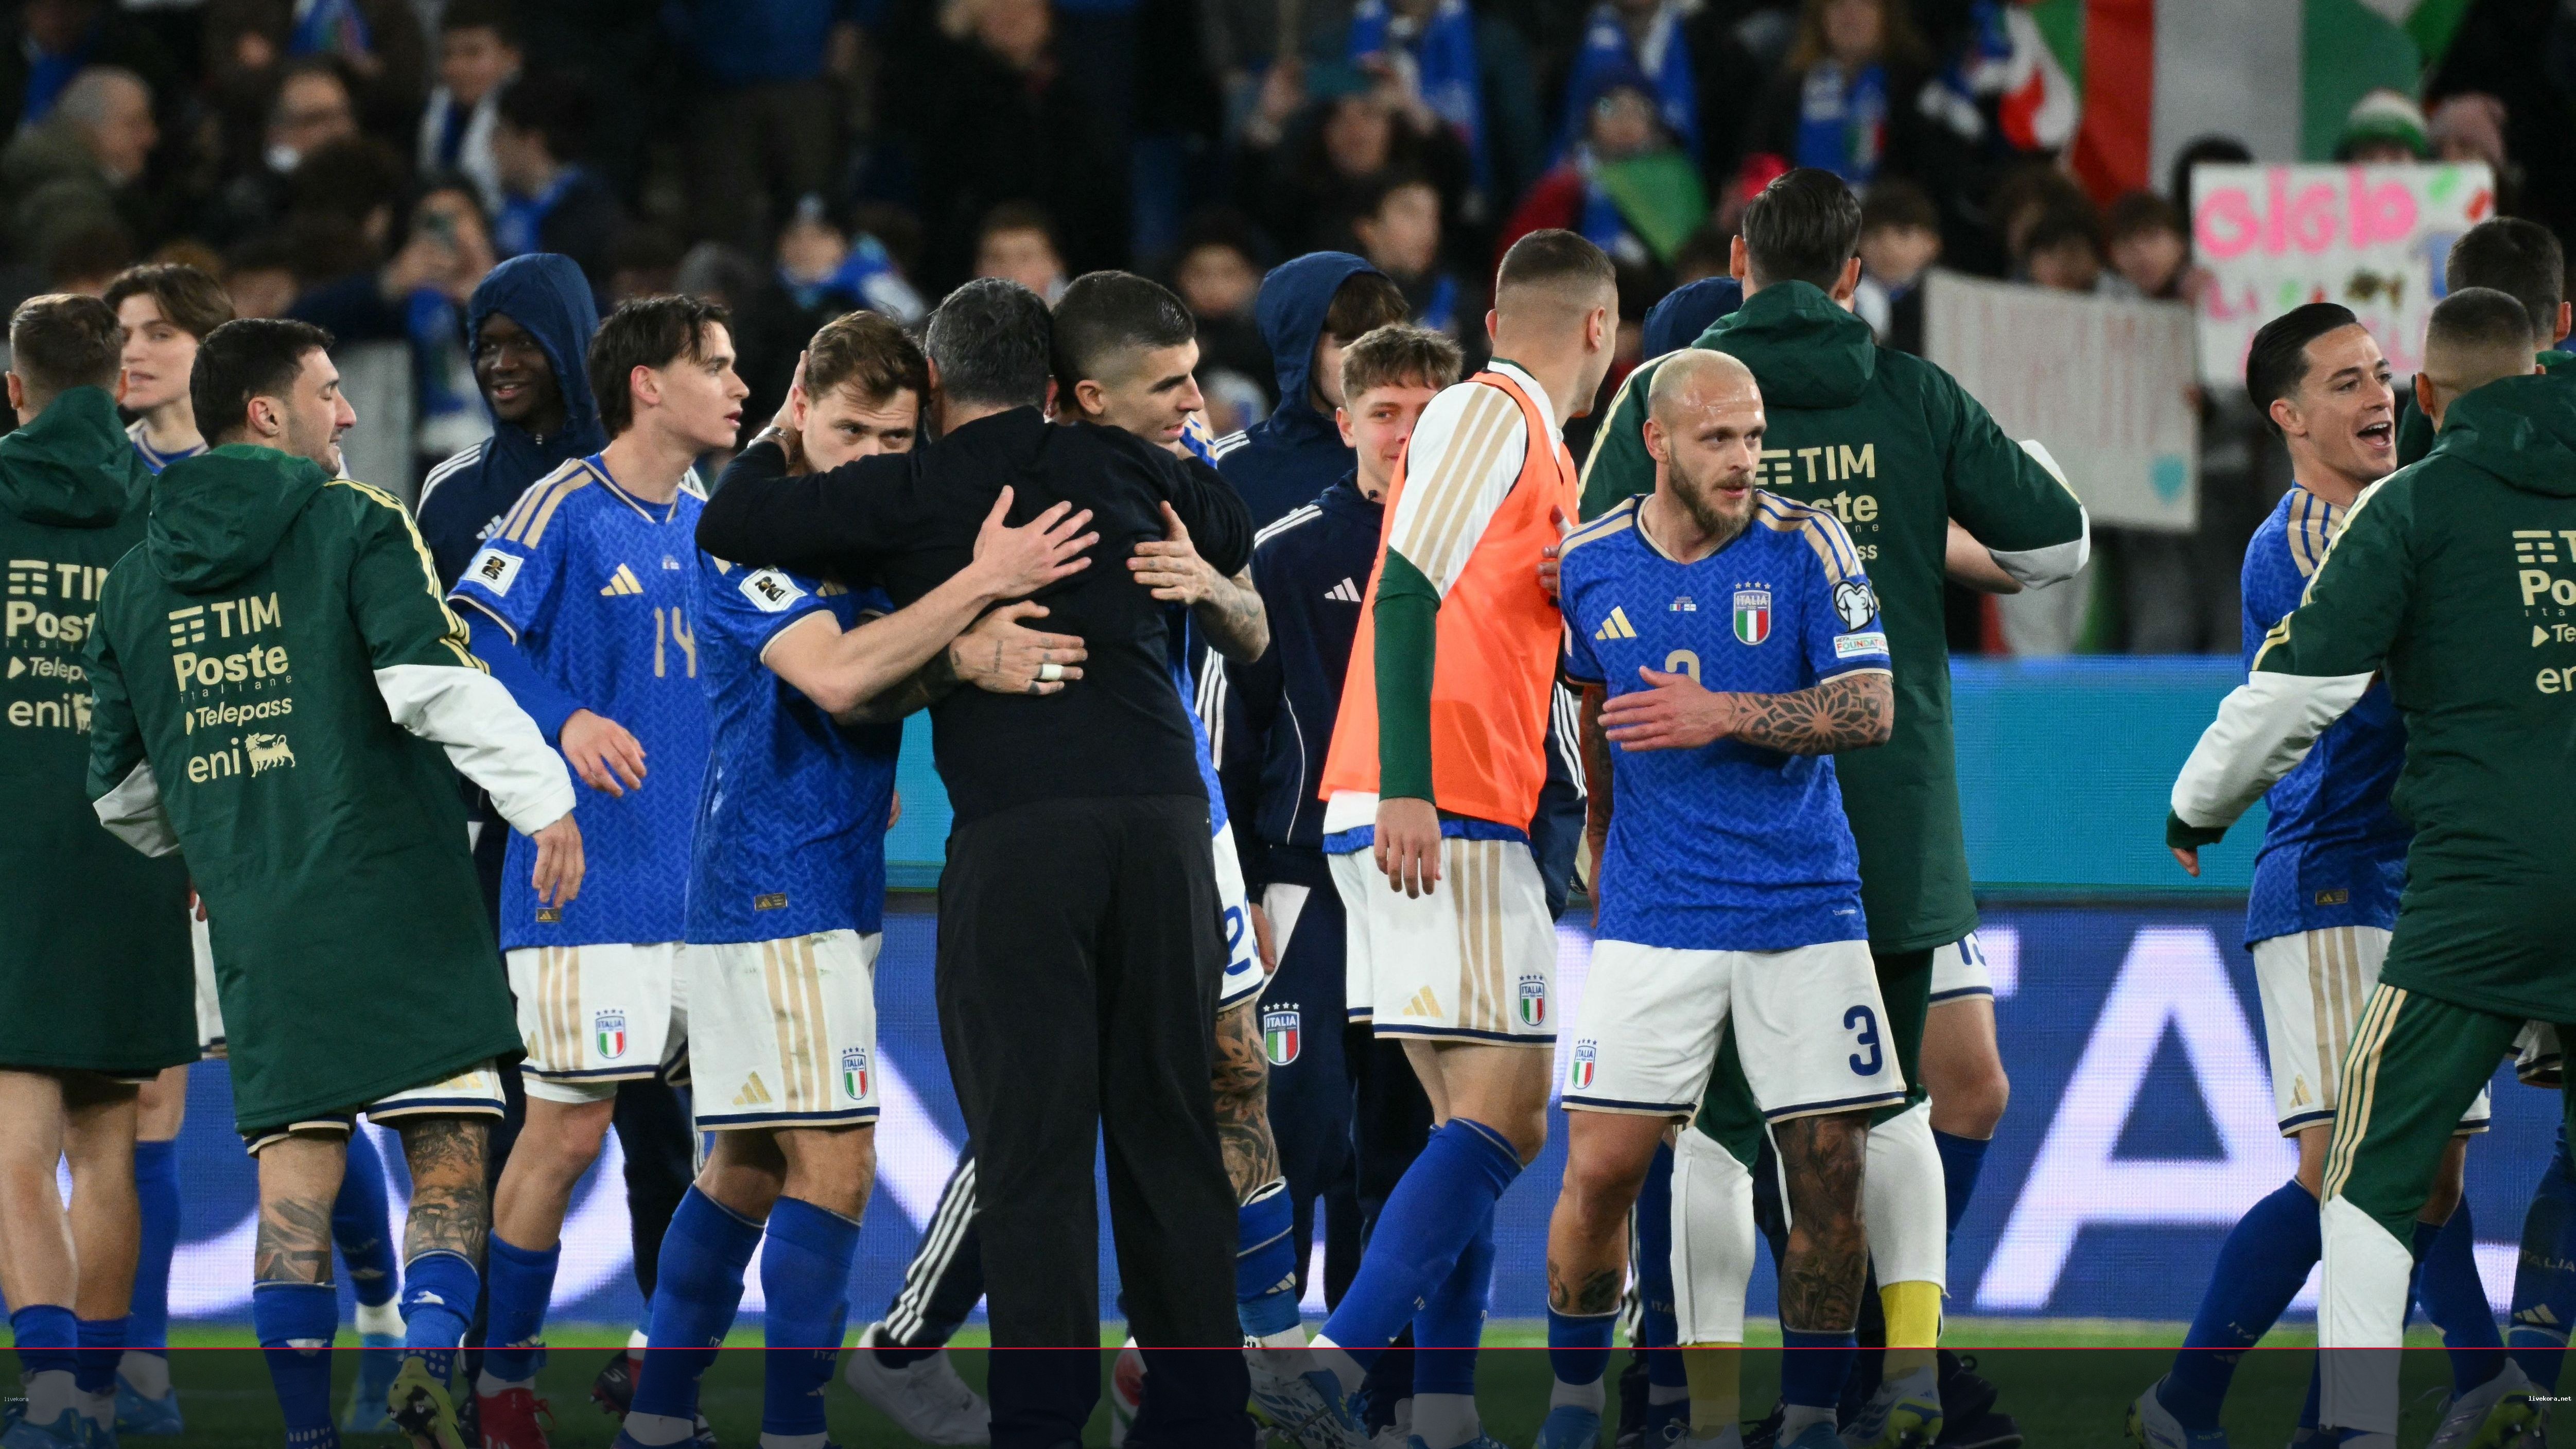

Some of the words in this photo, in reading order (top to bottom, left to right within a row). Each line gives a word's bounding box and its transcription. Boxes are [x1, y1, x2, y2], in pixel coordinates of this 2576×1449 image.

[1797, 443, 1876, 483] TIM
[211, 591, 282, 638] TIM
[1736, 595, 1767, 605] ITALIA
[29, 656, 88, 684] Telep
[172, 643, 289, 692] Poste
[180, 673, 292, 703] italiane
[8, 693, 69, 728] eni
[195, 696, 292, 727] Telepass
[188, 737, 241, 783] eni
[1521, 985, 1542, 994] ITALIA
[1266, 1016, 1297, 1028] ITALIA
[1843, 1005, 1883, 1076] 3
[844, 1058, 864, 1068] ITALIA
